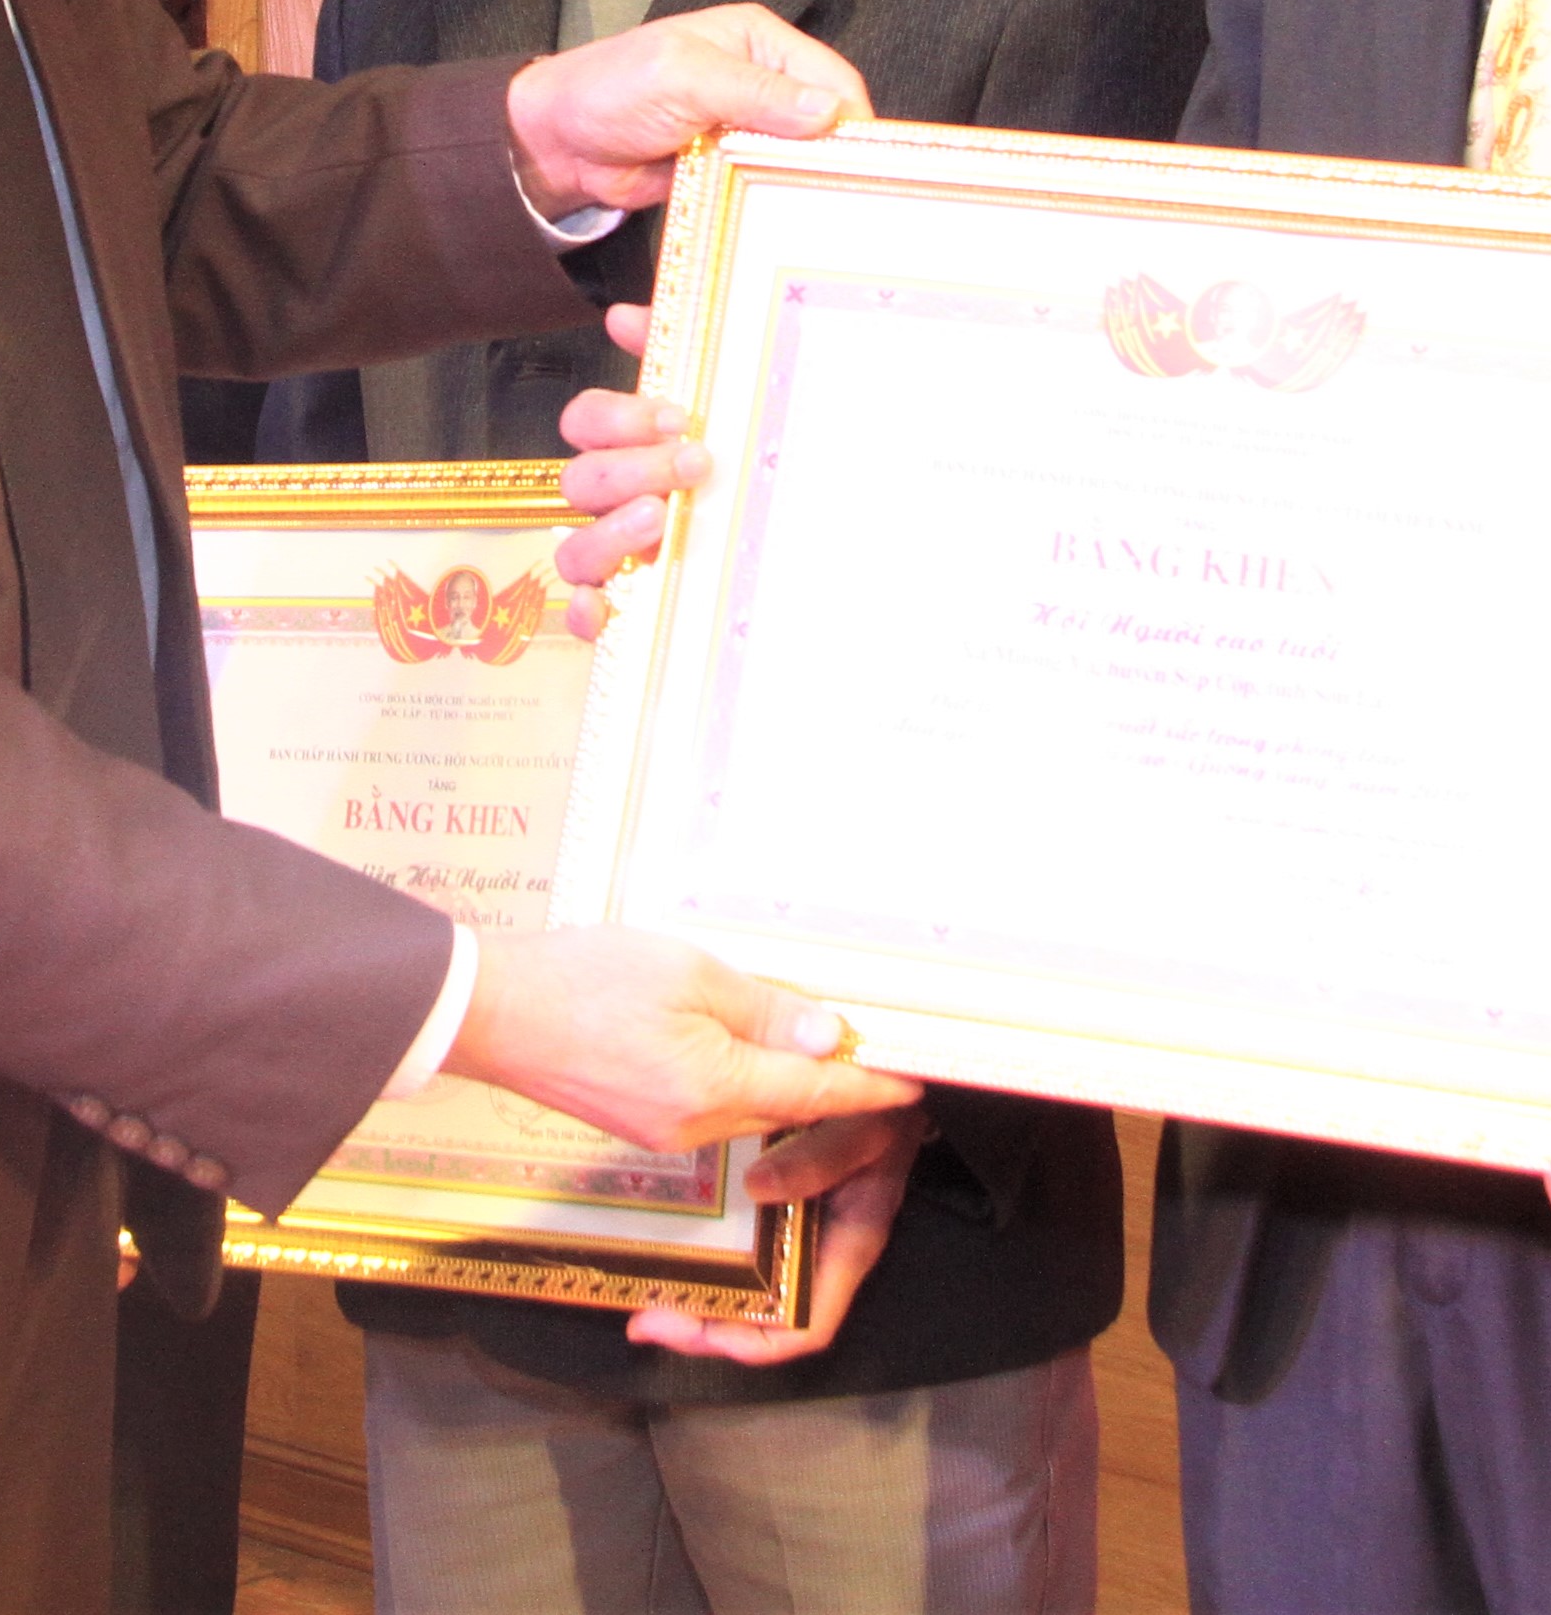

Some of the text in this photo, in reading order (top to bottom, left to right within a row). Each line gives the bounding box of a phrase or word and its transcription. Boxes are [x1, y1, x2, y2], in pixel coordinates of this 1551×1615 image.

[1200, 546, 1340, 598] KHEN
[268, 746, 291, 761] BAN
[361, 749, 403, 765] TRUNG
[342, 784, 531, 838] BẰNG KHEN
[526, 876, 549, 892] ca
